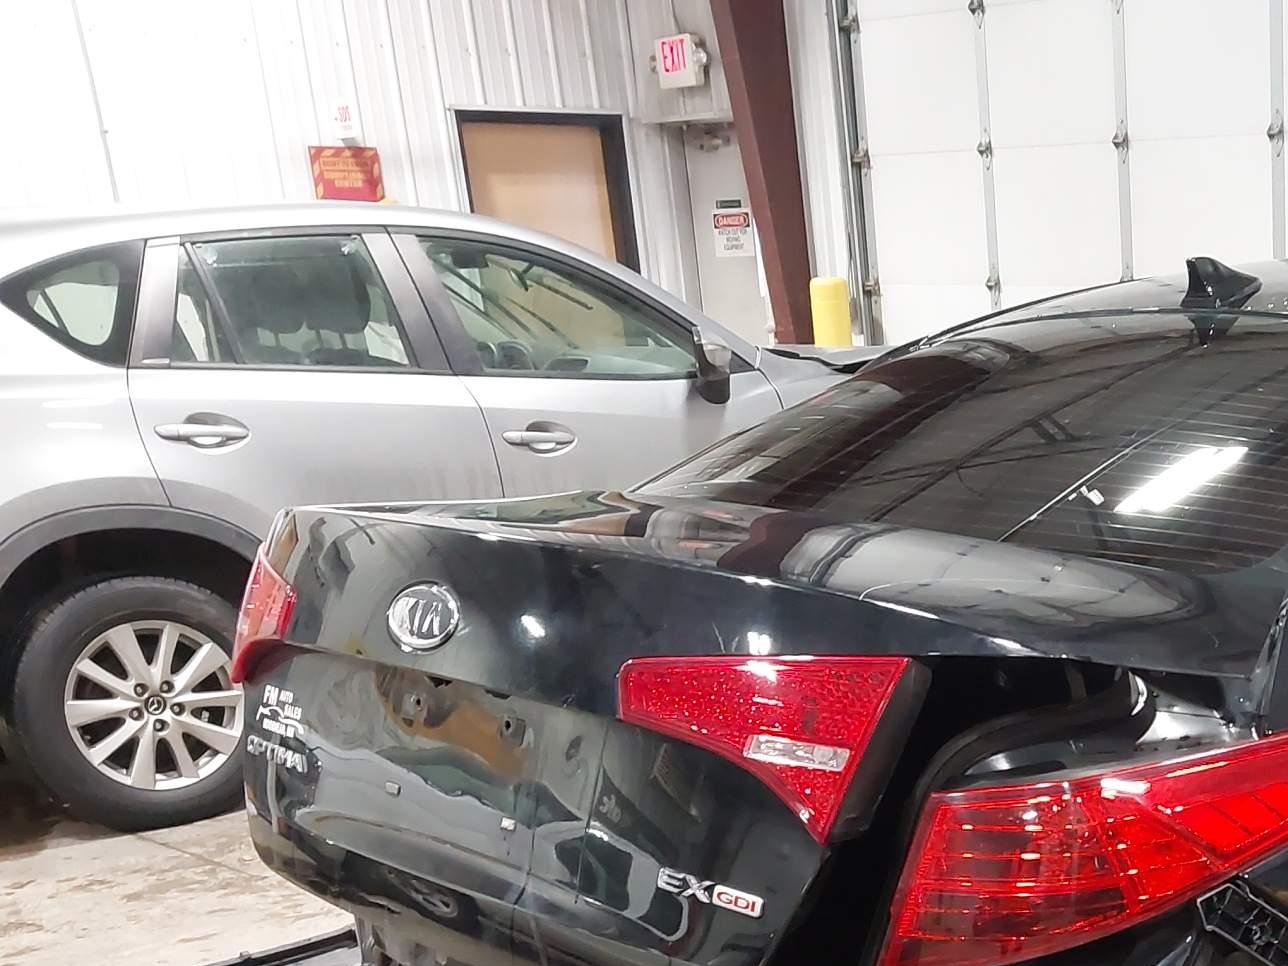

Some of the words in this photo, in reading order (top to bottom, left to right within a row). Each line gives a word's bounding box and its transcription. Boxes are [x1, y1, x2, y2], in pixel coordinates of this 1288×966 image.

[661, 38, 686, 72] EXIT
[718, 215, 745, 226] DANGER
[263, 684, 279, 706] FM
[278, 689, 294, 704] AUTO
[283, 703, 302, 721] SALES
[247, 735, 308, 774] OPTIMA
[658, 867, 715, 903] EX
[716, 891, 757, 912] GDI
